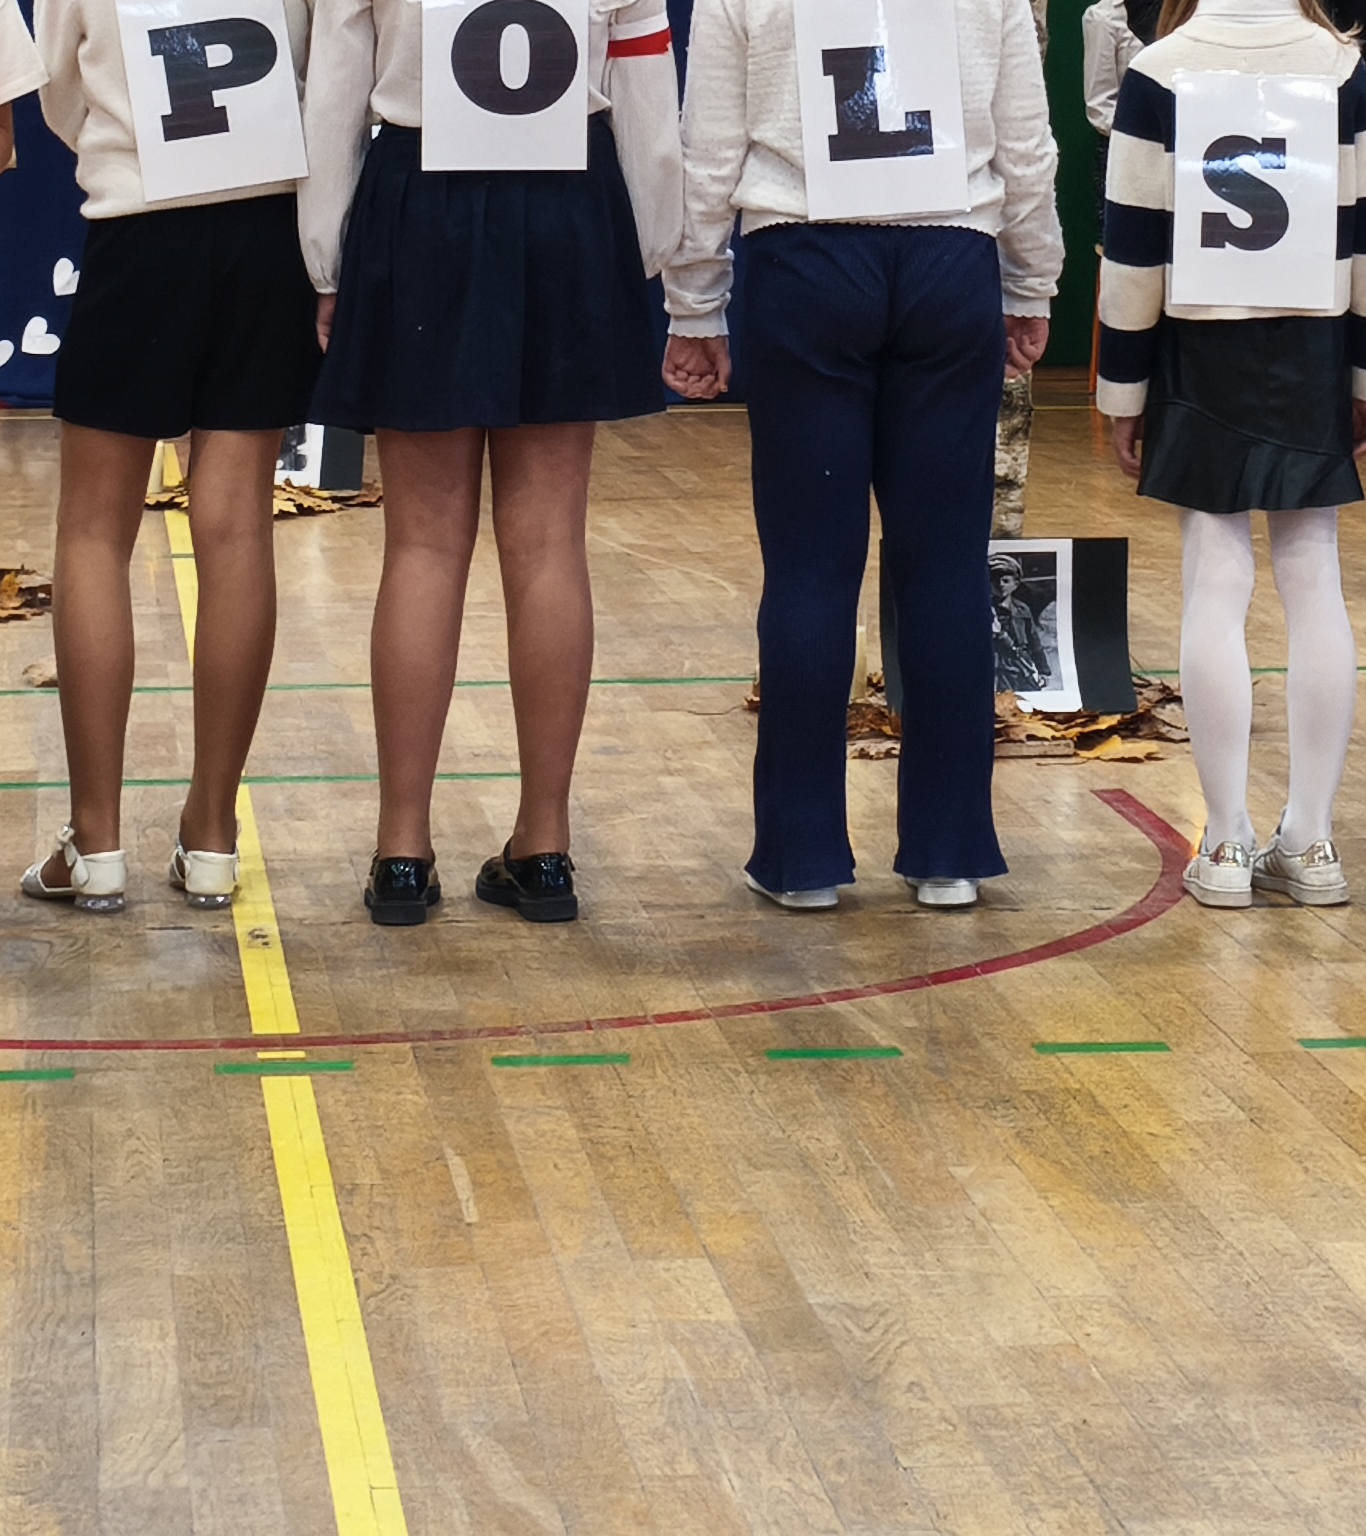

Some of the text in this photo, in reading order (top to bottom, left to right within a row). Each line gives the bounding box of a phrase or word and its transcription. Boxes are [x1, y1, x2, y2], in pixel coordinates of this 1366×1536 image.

[147, 17, 278, 142] P
[821, 45, 934, 162] L
[1200, 134, 1290, 252] S
